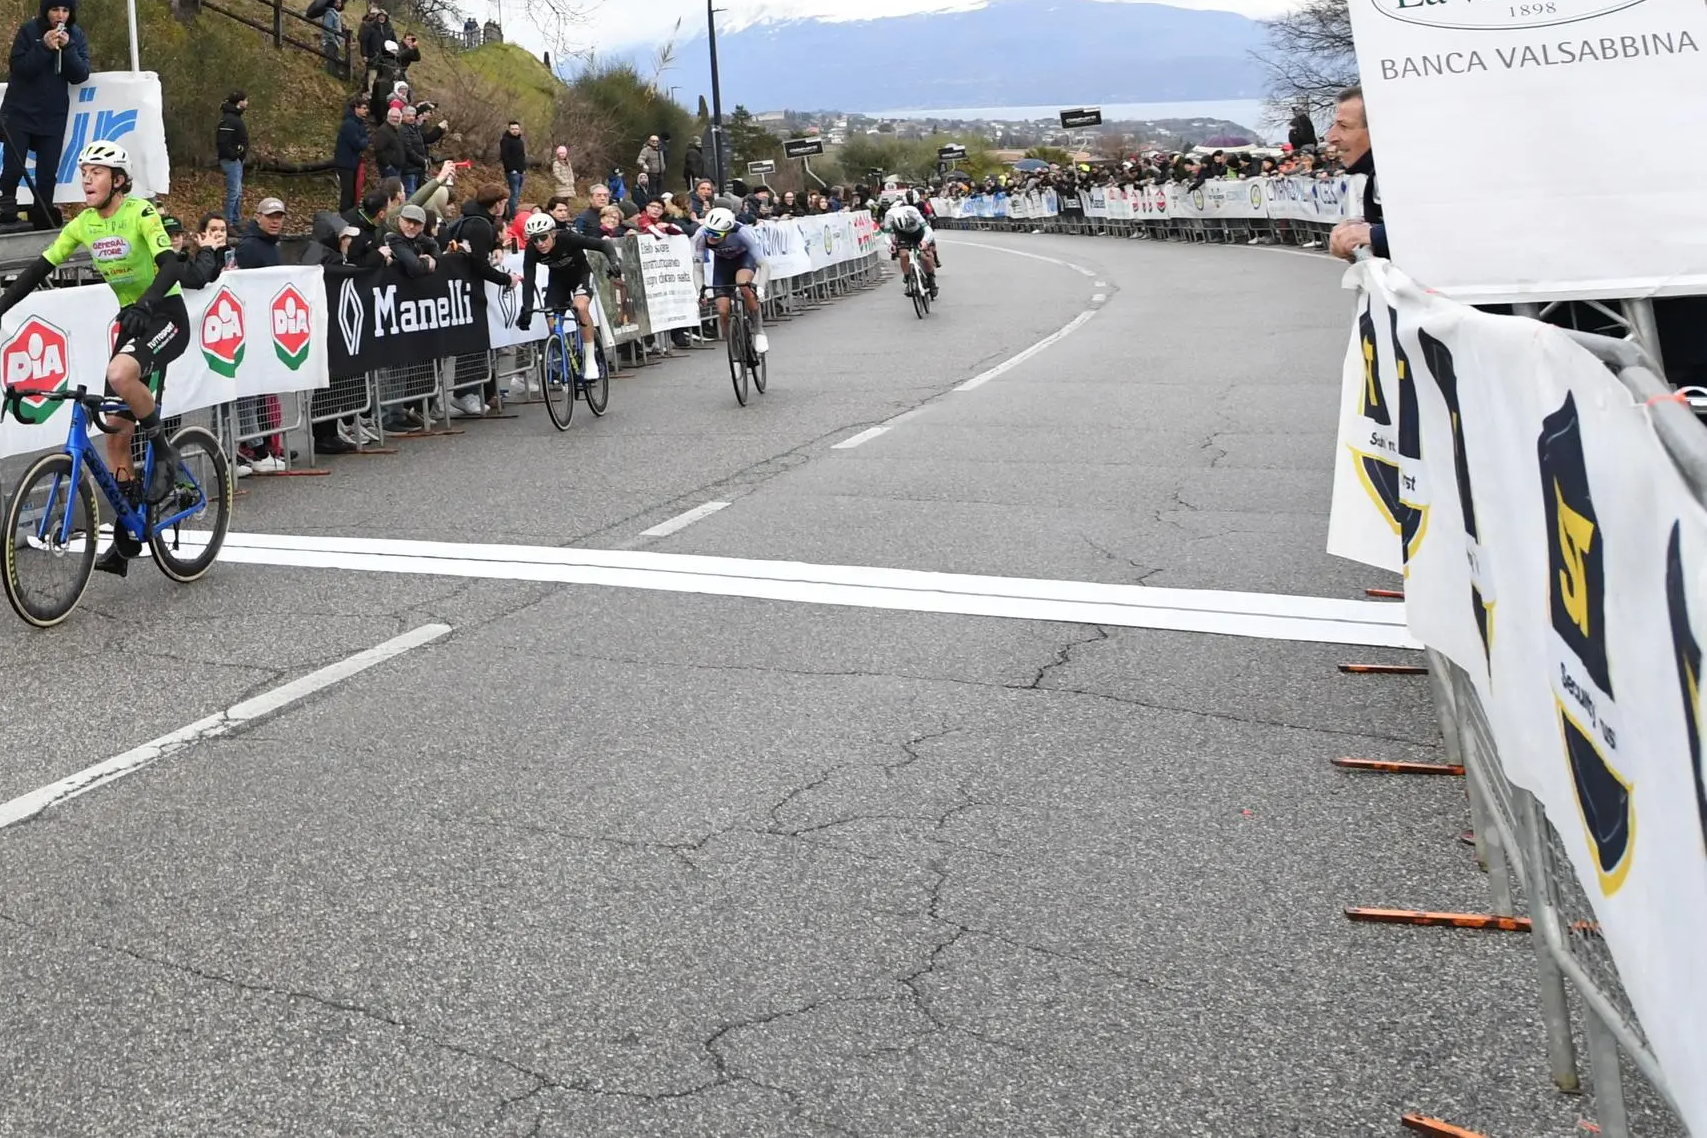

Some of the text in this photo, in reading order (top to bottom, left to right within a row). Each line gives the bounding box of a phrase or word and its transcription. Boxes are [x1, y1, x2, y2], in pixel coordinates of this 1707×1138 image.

[1509, 1, 1557, 18] 1898
[1380, 30, 1699, 81] BANCA VALSABBINA
[93, 238, 126, 250] GENERAL
[97, 248, 123, 258] STORE
[372, 279, 474, 337] Manelli
